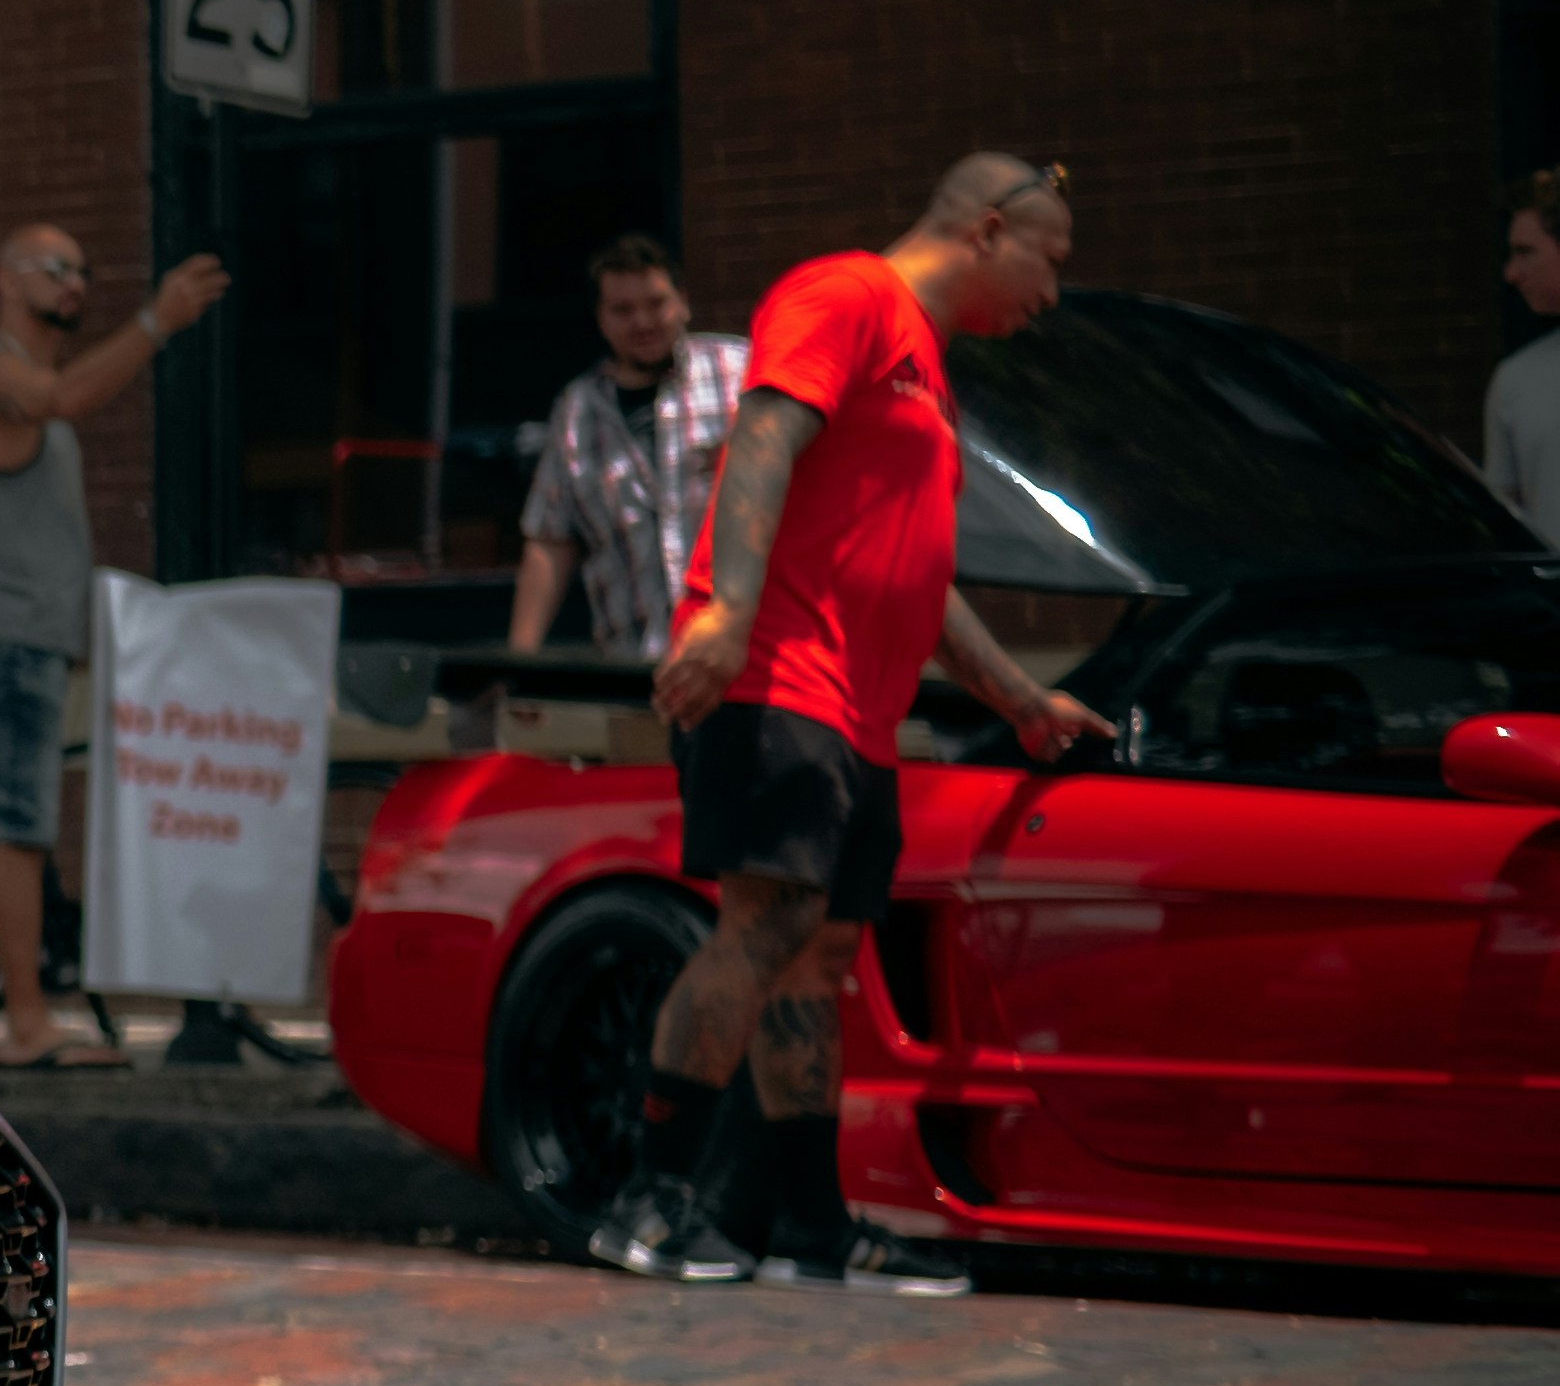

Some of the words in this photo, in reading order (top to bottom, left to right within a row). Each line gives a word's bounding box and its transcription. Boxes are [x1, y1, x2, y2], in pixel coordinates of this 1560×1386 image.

[112, 701, 154, 738] No
[162, 702, 303, 757] Parking
[117, 750, 180, 787] Tow
[190, 756, 289, 806] Away
[149, 800, 241, 844] Zone
